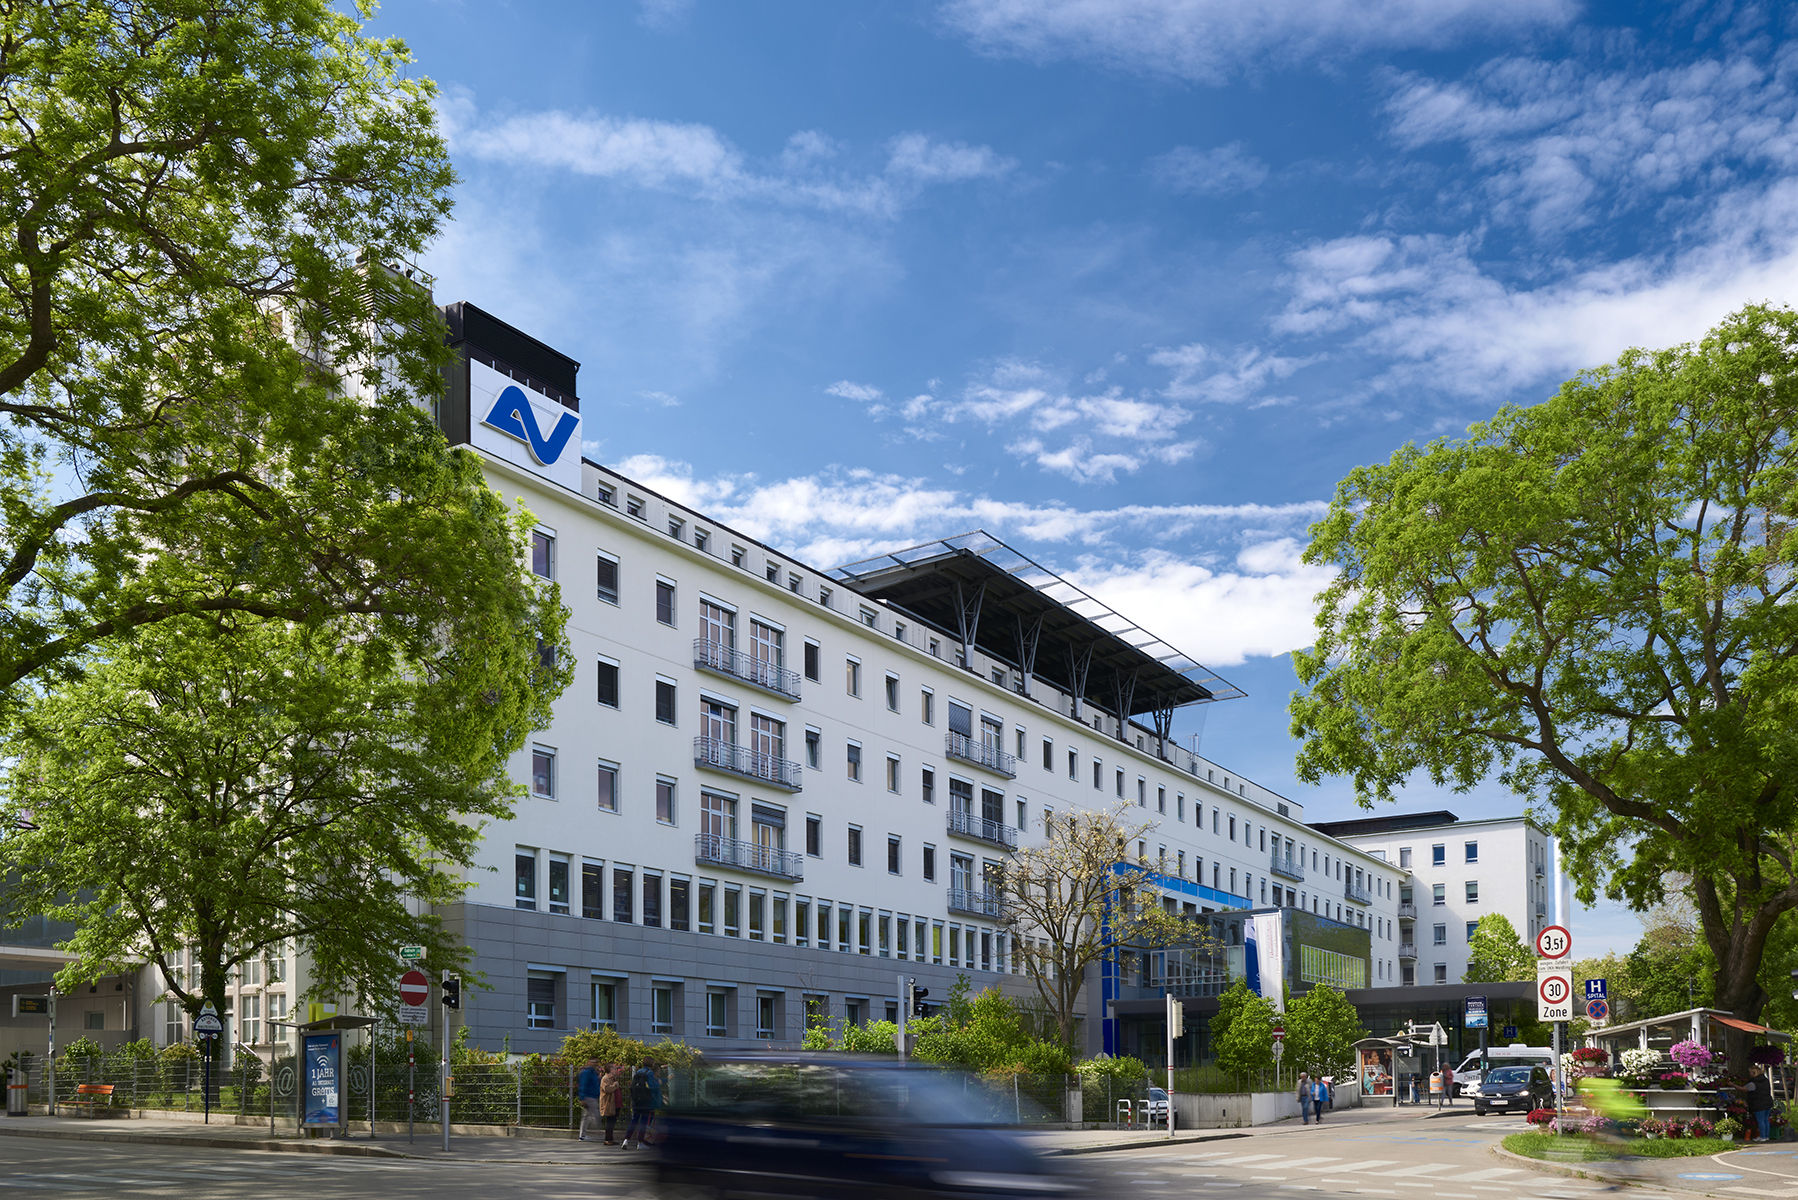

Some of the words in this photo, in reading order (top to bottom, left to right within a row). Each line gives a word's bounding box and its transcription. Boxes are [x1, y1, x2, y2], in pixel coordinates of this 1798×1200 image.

[1548, 984, 1561, 996] 30
[1590, 980, 1601, 992] H
[1544, 1007, 1568, 1018] Zone
[312, 1068, 316, 1078] 1
[317, 1068, 334, 1080] JAHR
[312, 1087, 335, 1096] GRATIS
